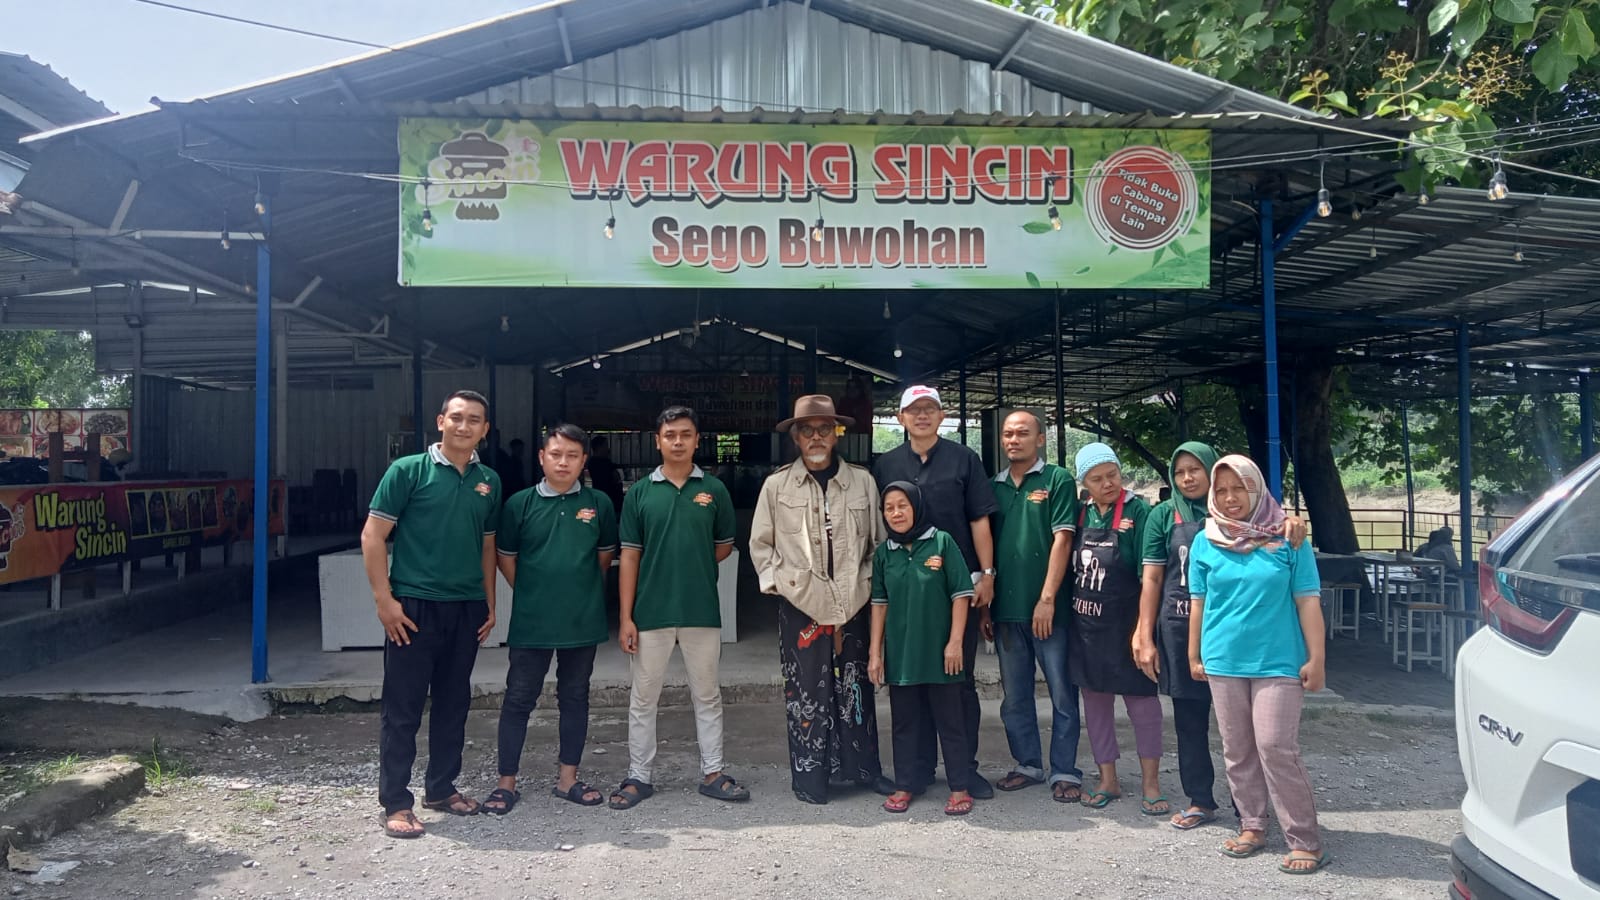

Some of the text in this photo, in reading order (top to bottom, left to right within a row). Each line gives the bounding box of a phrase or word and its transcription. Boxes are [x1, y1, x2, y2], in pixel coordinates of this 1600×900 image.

[558, 138, 1075, 207] WARUNG SINCIN
[1118, 168, 1179, 202] Tidak Buka
[1110, 194, 1167, 225] di Tempat
[1122, 185, 1164, 211] Cabang
[1120, 213, 1145, 230] Lain
[652, 217, 987, 272] Sego Buwohan
[35, 492, 107, 532] Warung
[76, 522, 127, 560] Sincin
[1479, 714, 1524, 747] CR-V
